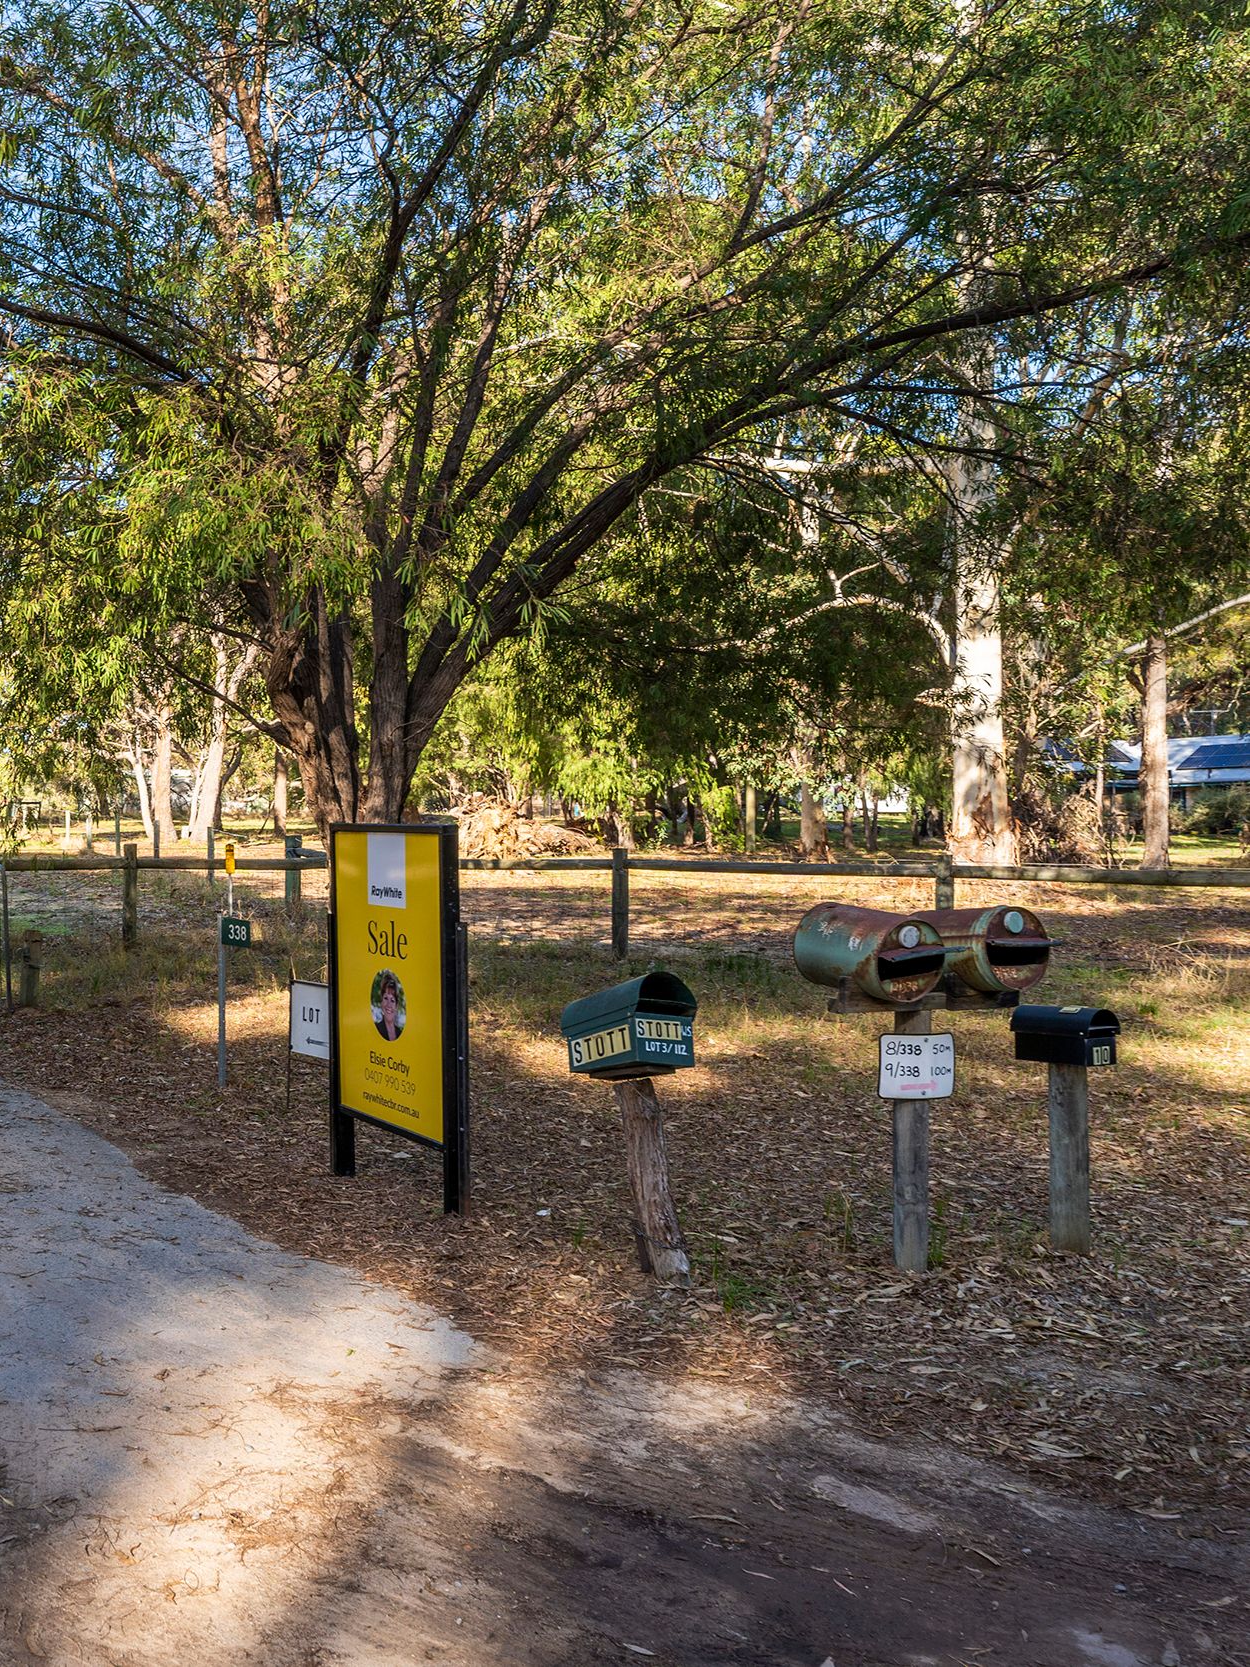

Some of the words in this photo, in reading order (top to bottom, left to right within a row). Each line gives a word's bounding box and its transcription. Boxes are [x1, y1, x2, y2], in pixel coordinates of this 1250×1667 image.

[228, 924, 247, 941] 338
[367, 920, 408, 960] Sale
[302, 1006, 321, 1024] LOT
[636, 1020, 680, 1039] STOTT
[573, 1027, 627, 1064] STOTT
[885, 1041, 923, 1056] 8/338
[370, 1050, 386, 1067] Elsie
[387, 1056, 410, 1077] Corby
[1094, 1047, 1109, 1063] 10
[884, 1061, 921, 1079] 9/338
[364, 1067, 383, 1084] 0407
[384, 1074, 400, 1091] 990
[401, 1079, 416, 1096] 539
